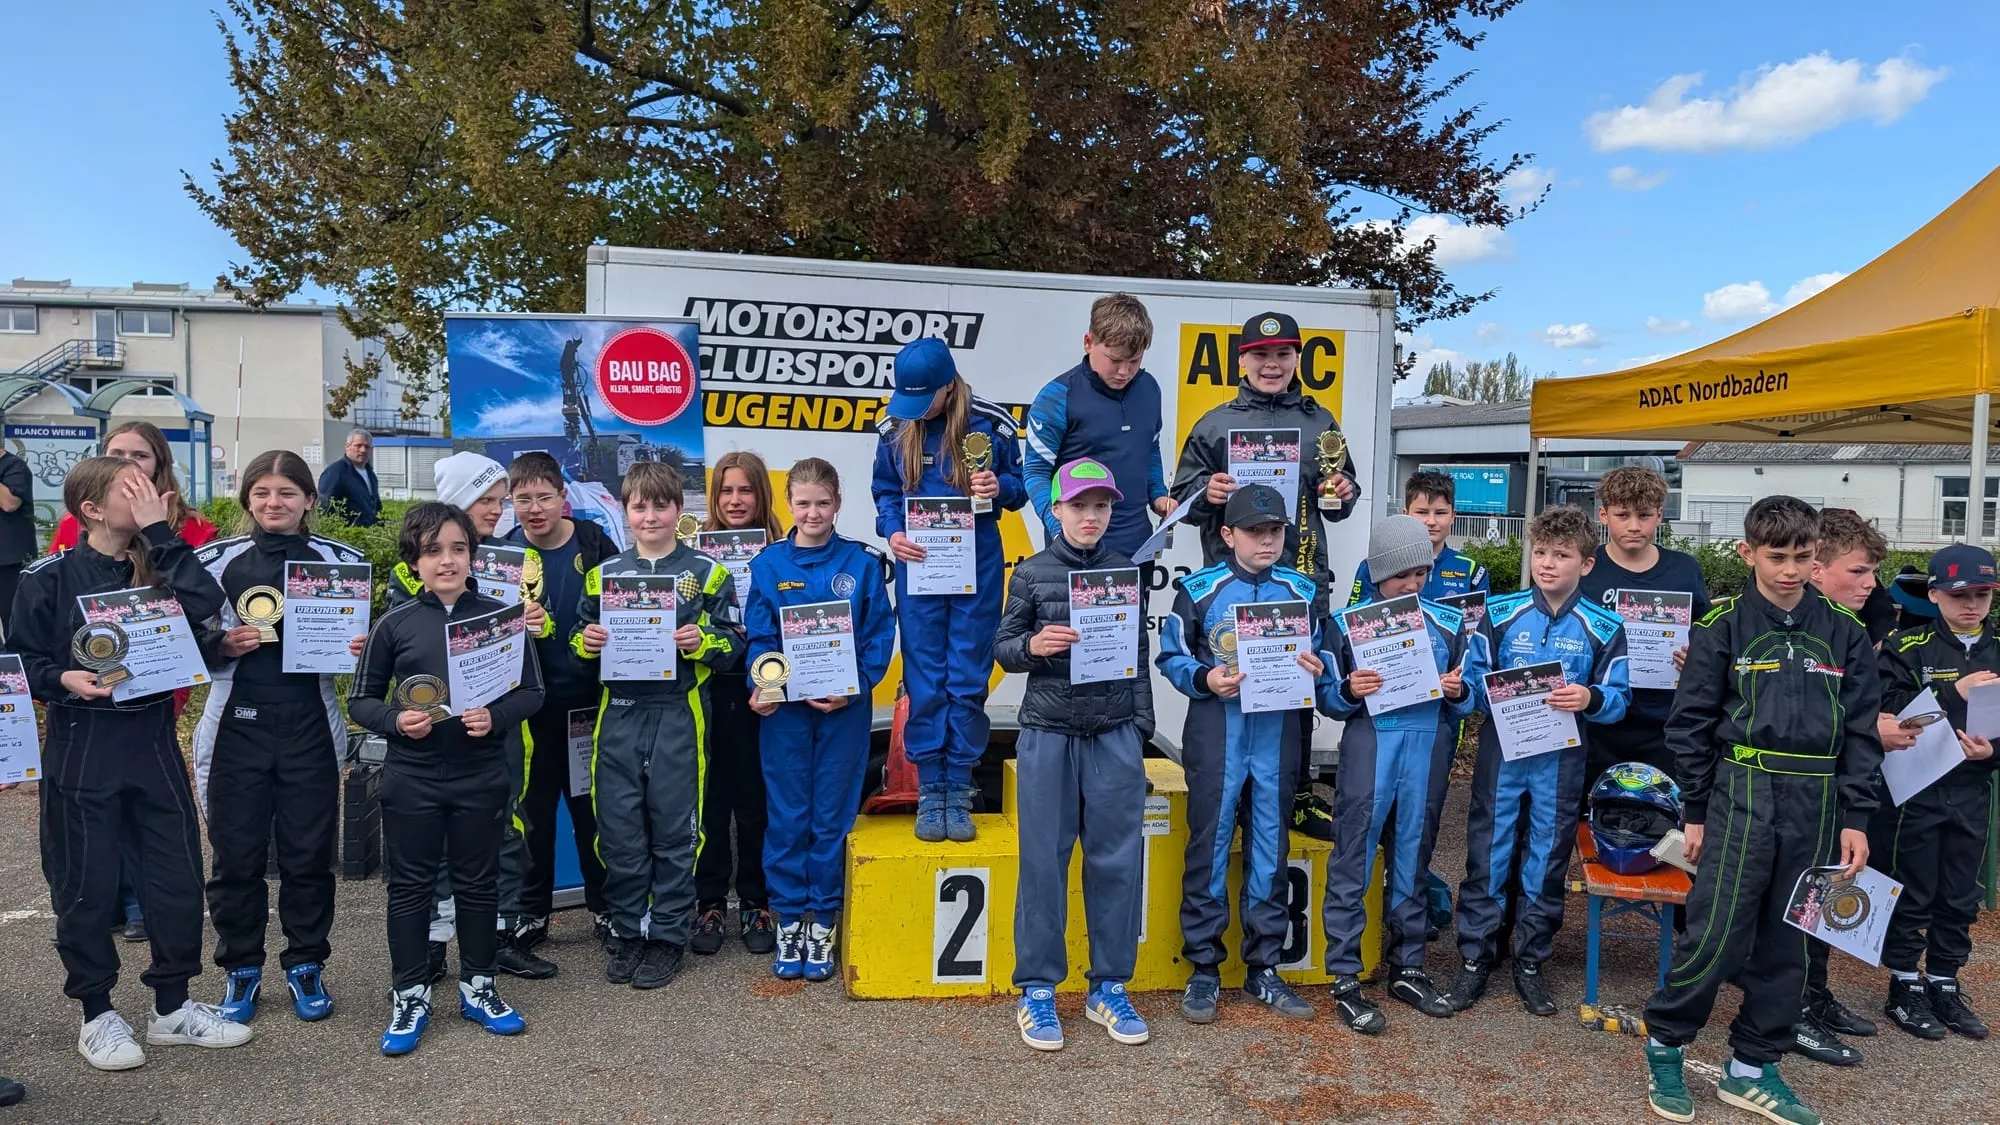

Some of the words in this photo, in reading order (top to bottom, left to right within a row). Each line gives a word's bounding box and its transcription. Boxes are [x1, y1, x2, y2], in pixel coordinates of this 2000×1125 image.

[691, 299, 977, 347] MOTORSPORT
[609, 360, 645, 382] BAU
[648, 361, 681, 383] BAG
[699, 345, 896, 388] CLUBSPOR
[610, 384, 630, 394] KLEIN,
[631, 384, 654, 394] SMART,
[655, 384, 682, 395] GÜNSTIG
[1639, 384, 1683, 409] ADAC
[1689, 369, 1788, 403] Nordbaden
[14, 428, 50, 437] BLANCO
[51, 428, 76, 437] WERK
[78, 429, 87, 437] III
[1300, 495, 1309, 533] Team
[1297, 535, 1309, 574] ADAC
[1307, 530, 1317, 575] Nordbaden
[1190, 580, 1208, 592] OMP
[297, 606, 342, 615] URKUNDE
[1491, 605, 1509, 615] OMP
[610, 617, 650, 625] URKUNDE
[1080, 614, 1118, 625] URKUNDE
[1439, 612, 1458, 623] OMP
[1594, 619, 1613, 634] OMP
[793, 641, 831, 652] URKUNDE
[1555, 636, 1584, 646] AUTOHAUS
[1247, 644, 1286, 655] URKUNDE
[1363, 642, 1404, 658] URKUNDE
[1554, 642, 1584, 652] KNOPF
[460, 649, 501, 668] URKUNDE
[1502, 700, 1544, 714] URKUNDE
[235, 708, 258, 718] OMP
[1376, 717, 1398, 727] OMP
[937, 875, 985, 977] 2
